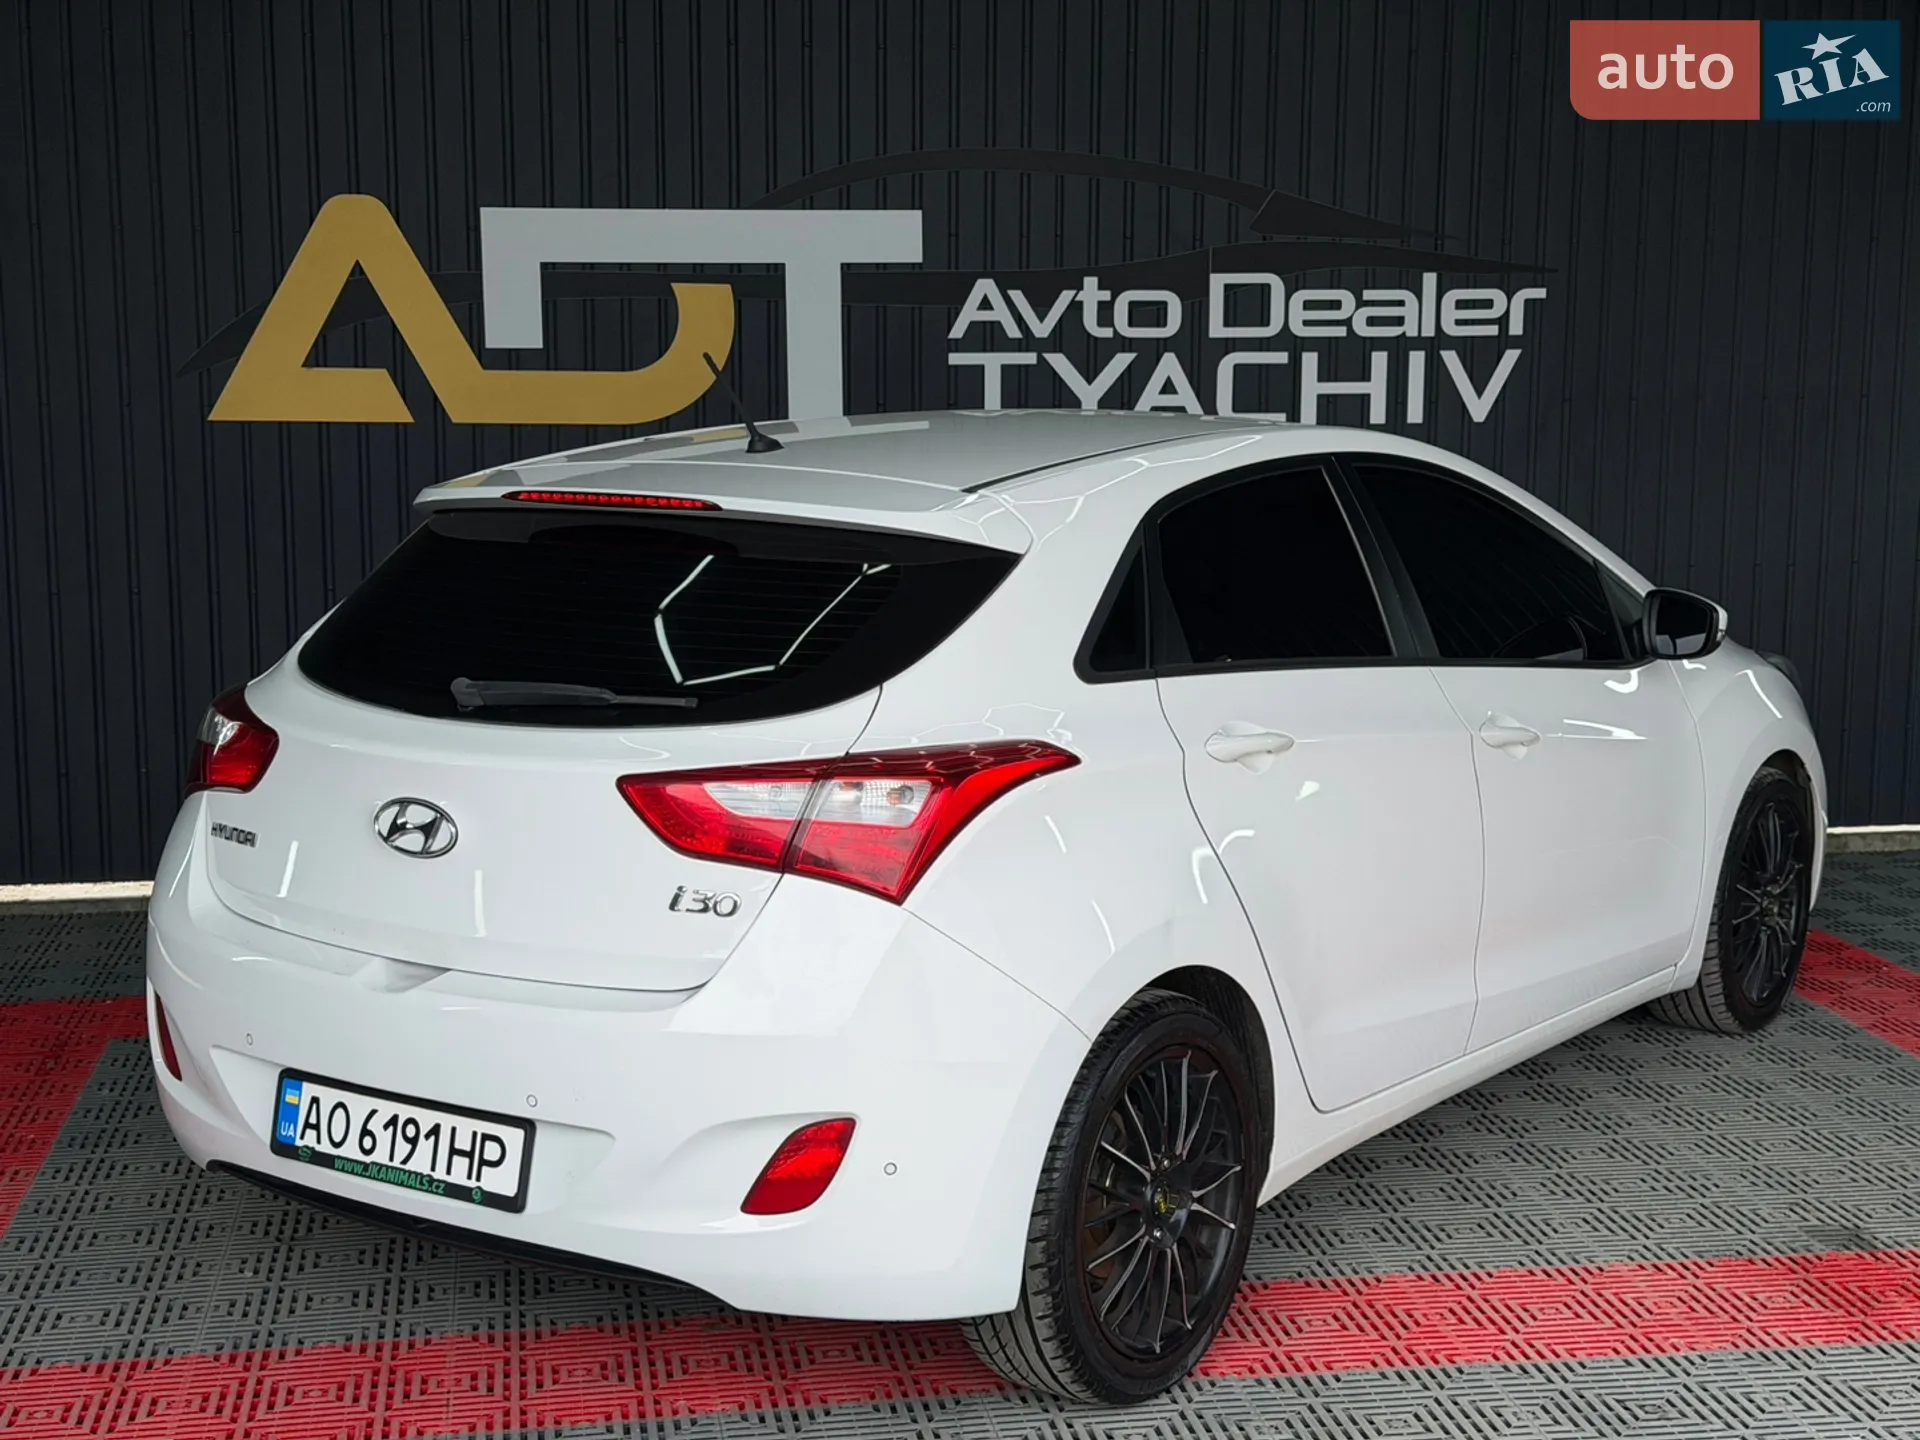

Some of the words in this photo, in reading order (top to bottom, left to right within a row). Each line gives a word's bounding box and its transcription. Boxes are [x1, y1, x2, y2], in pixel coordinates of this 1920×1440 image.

[947, 276, 1183, 339] Avto
[1208, 271, 1548, 338] Dealer
[947, 348, 1523, 426] TYACHIV
[210, 820, 257, 849] HYUNDAI
[668, 885, 742, 918] i30
[280, 1120, 296, 1138] UA
